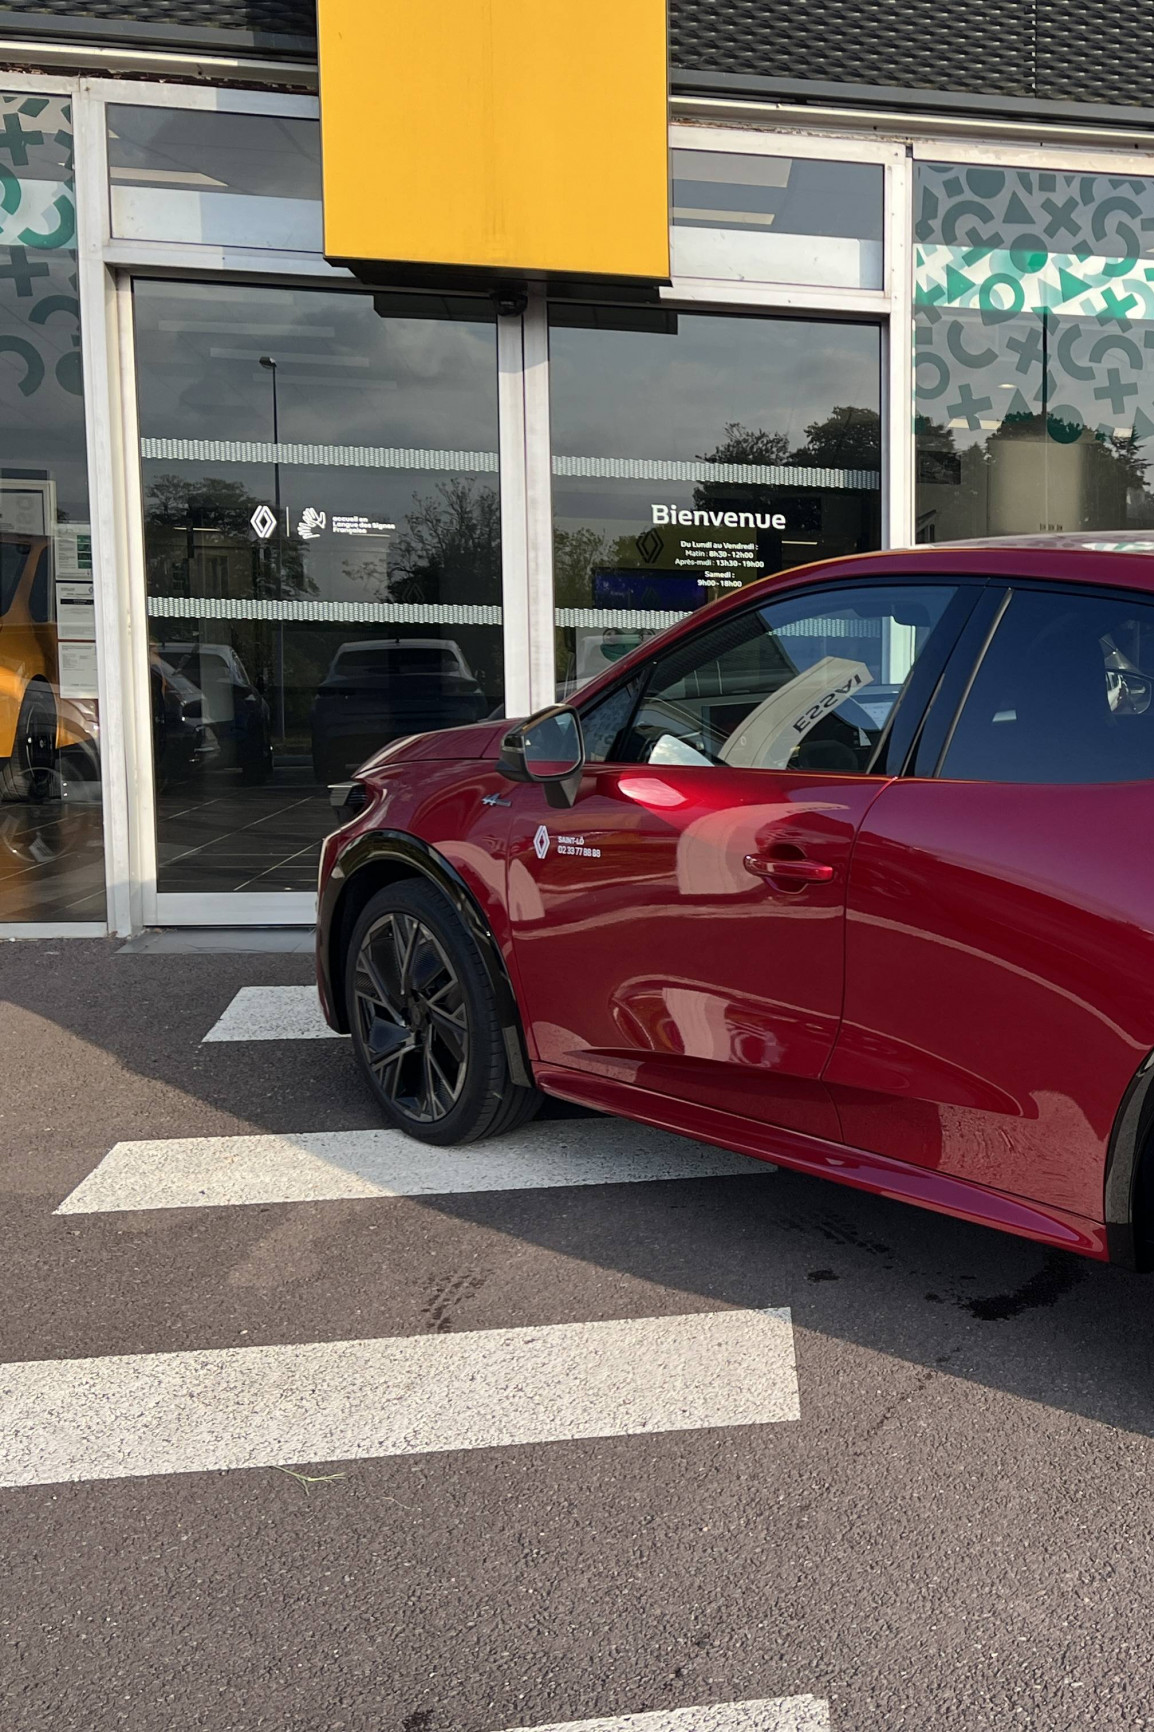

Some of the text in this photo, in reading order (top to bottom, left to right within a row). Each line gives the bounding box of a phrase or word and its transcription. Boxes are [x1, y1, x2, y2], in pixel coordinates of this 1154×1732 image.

[651, 504, 786, 529] Bienvenue
[692, 541, 712, 549] Lundi
[723, 542, 754, 550] Vendredi
[675, 559, 711, 567] Après-midi
[697, 579, 716, 587] 9h00
[721, 580, 742, 588] 18h00
[558, 845, 566, 854] 02
[567, 846, 575, 855] 33
[575, 847, 583, 855] 77
